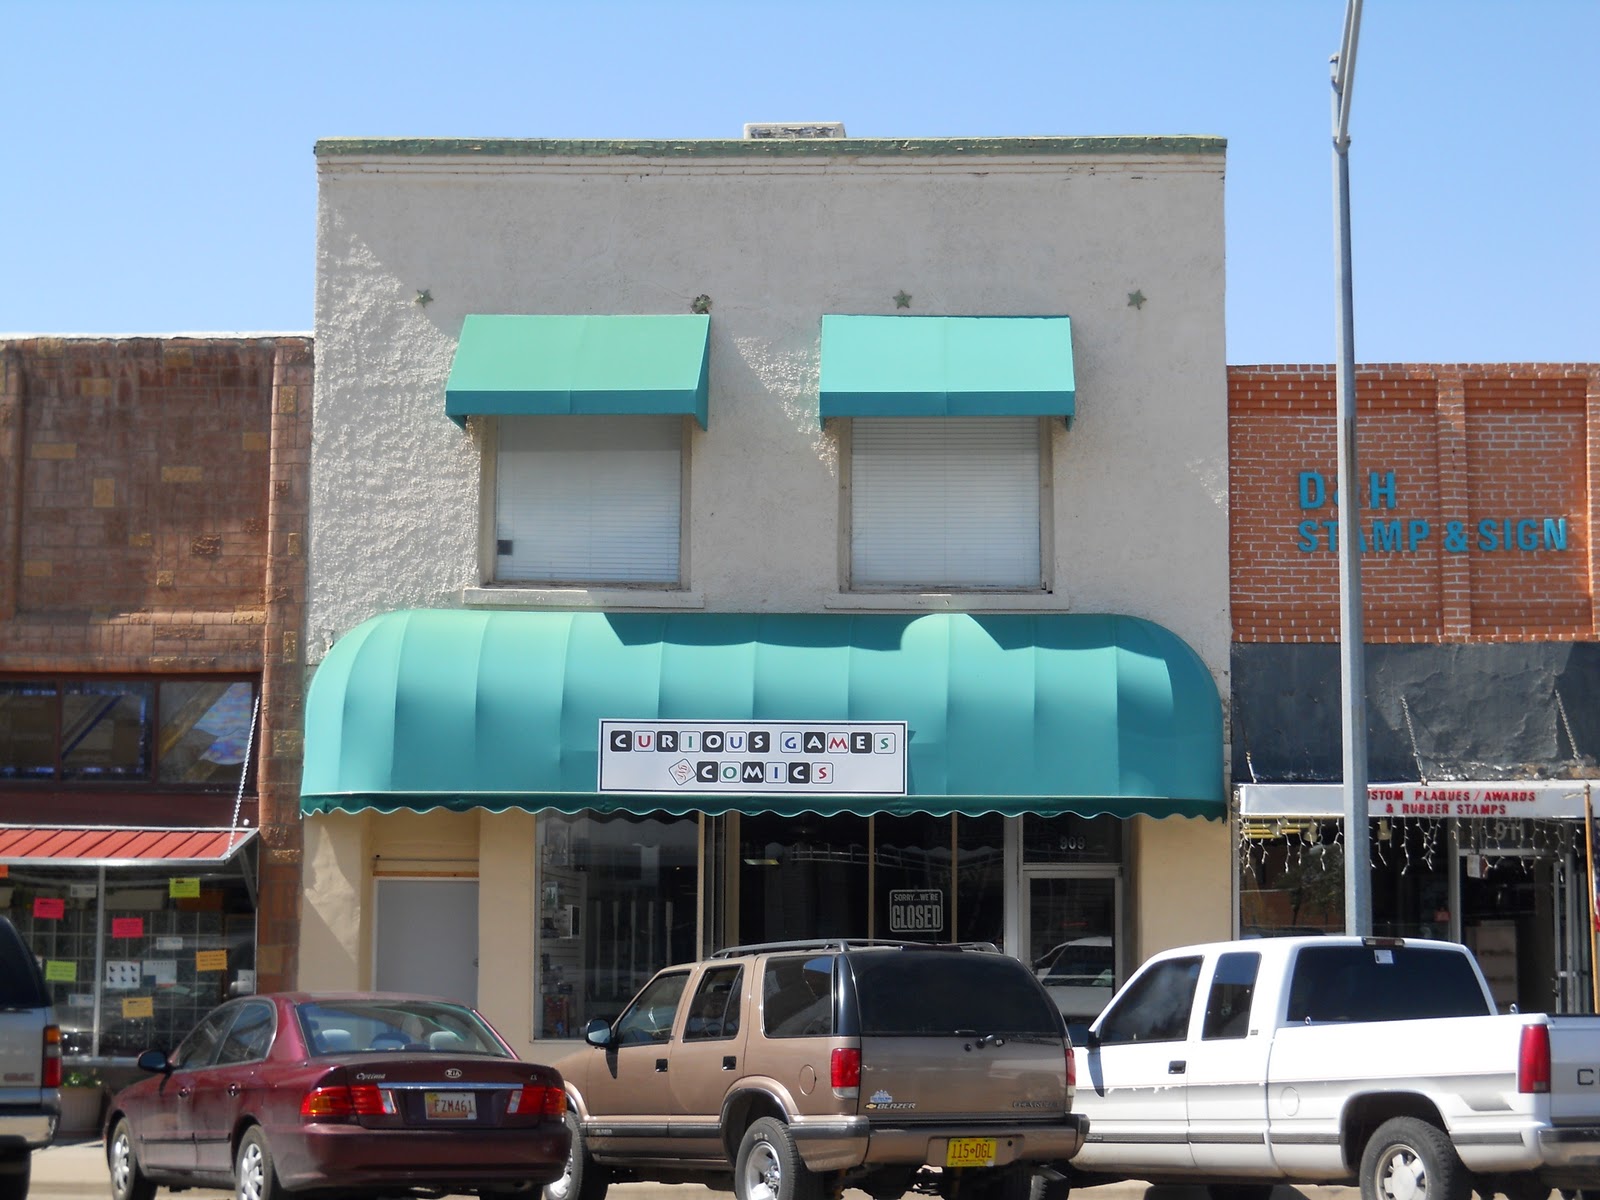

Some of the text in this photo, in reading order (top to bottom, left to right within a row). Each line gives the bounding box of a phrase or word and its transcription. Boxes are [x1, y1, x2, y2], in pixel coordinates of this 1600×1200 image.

[1299, 472, 1325, 509] D
[1369, 472, 1396, 509] H
[1443, 520, 1469, 552] &
[1478, 517, 1567, 551] SIGN
[613, 732, 890, 750] CURIOUS GAMES
[700, 763, 829, 780] COMICS
[1415, 791, 1470, 801] PLAQUES
[1484, 791, 1536, 802] AWARDS
[1386, 803, 1507, 815] & RUBBER STAMPS
[892, 904, 941, 929] CLOSED
[356, 1072, 386, 1081] Optima
